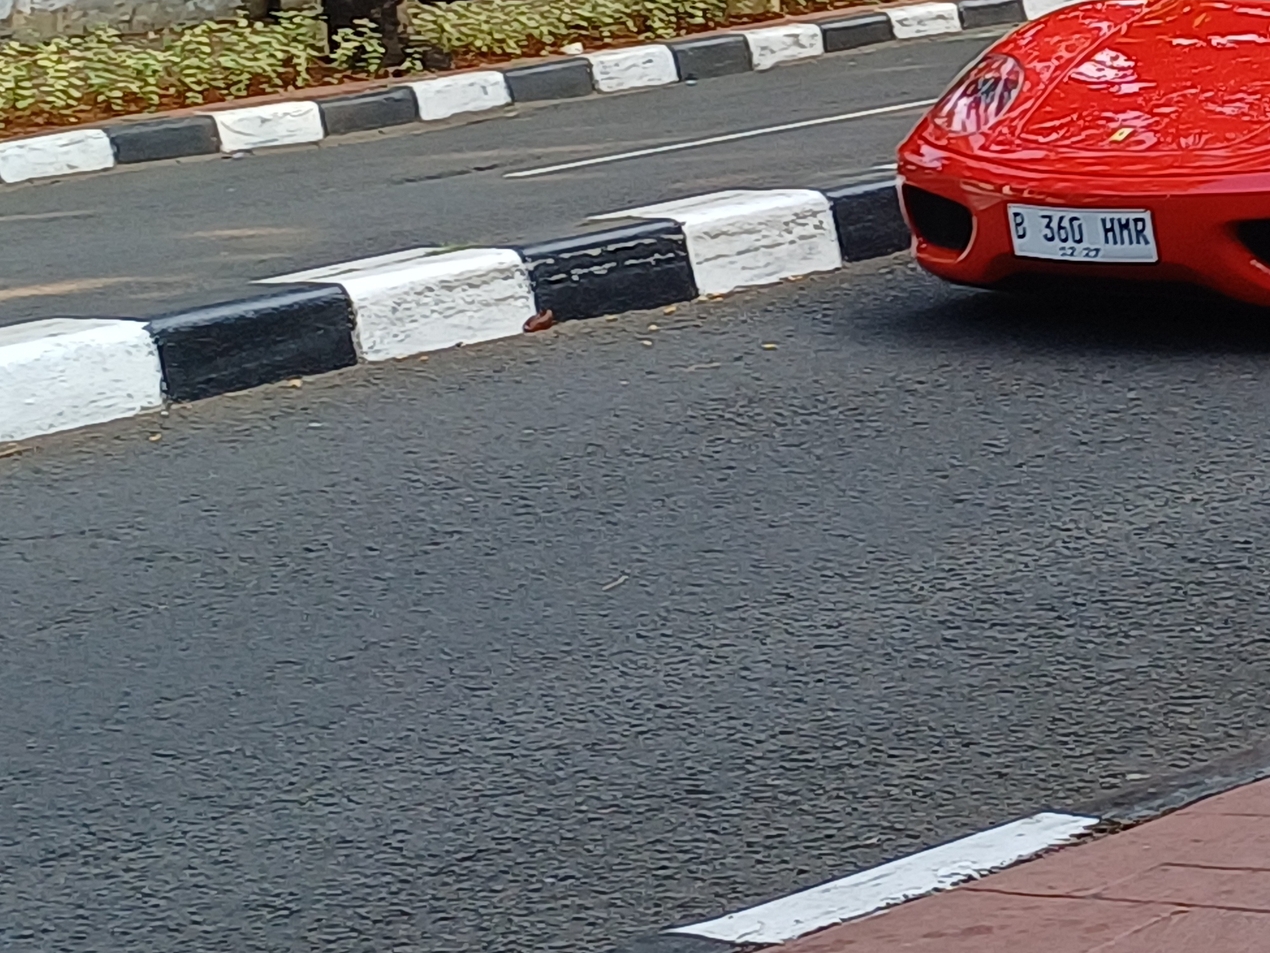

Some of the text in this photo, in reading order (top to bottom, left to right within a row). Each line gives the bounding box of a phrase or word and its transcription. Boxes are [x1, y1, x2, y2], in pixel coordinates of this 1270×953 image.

[1012, 212, 1151, 246] B 360 HMR
